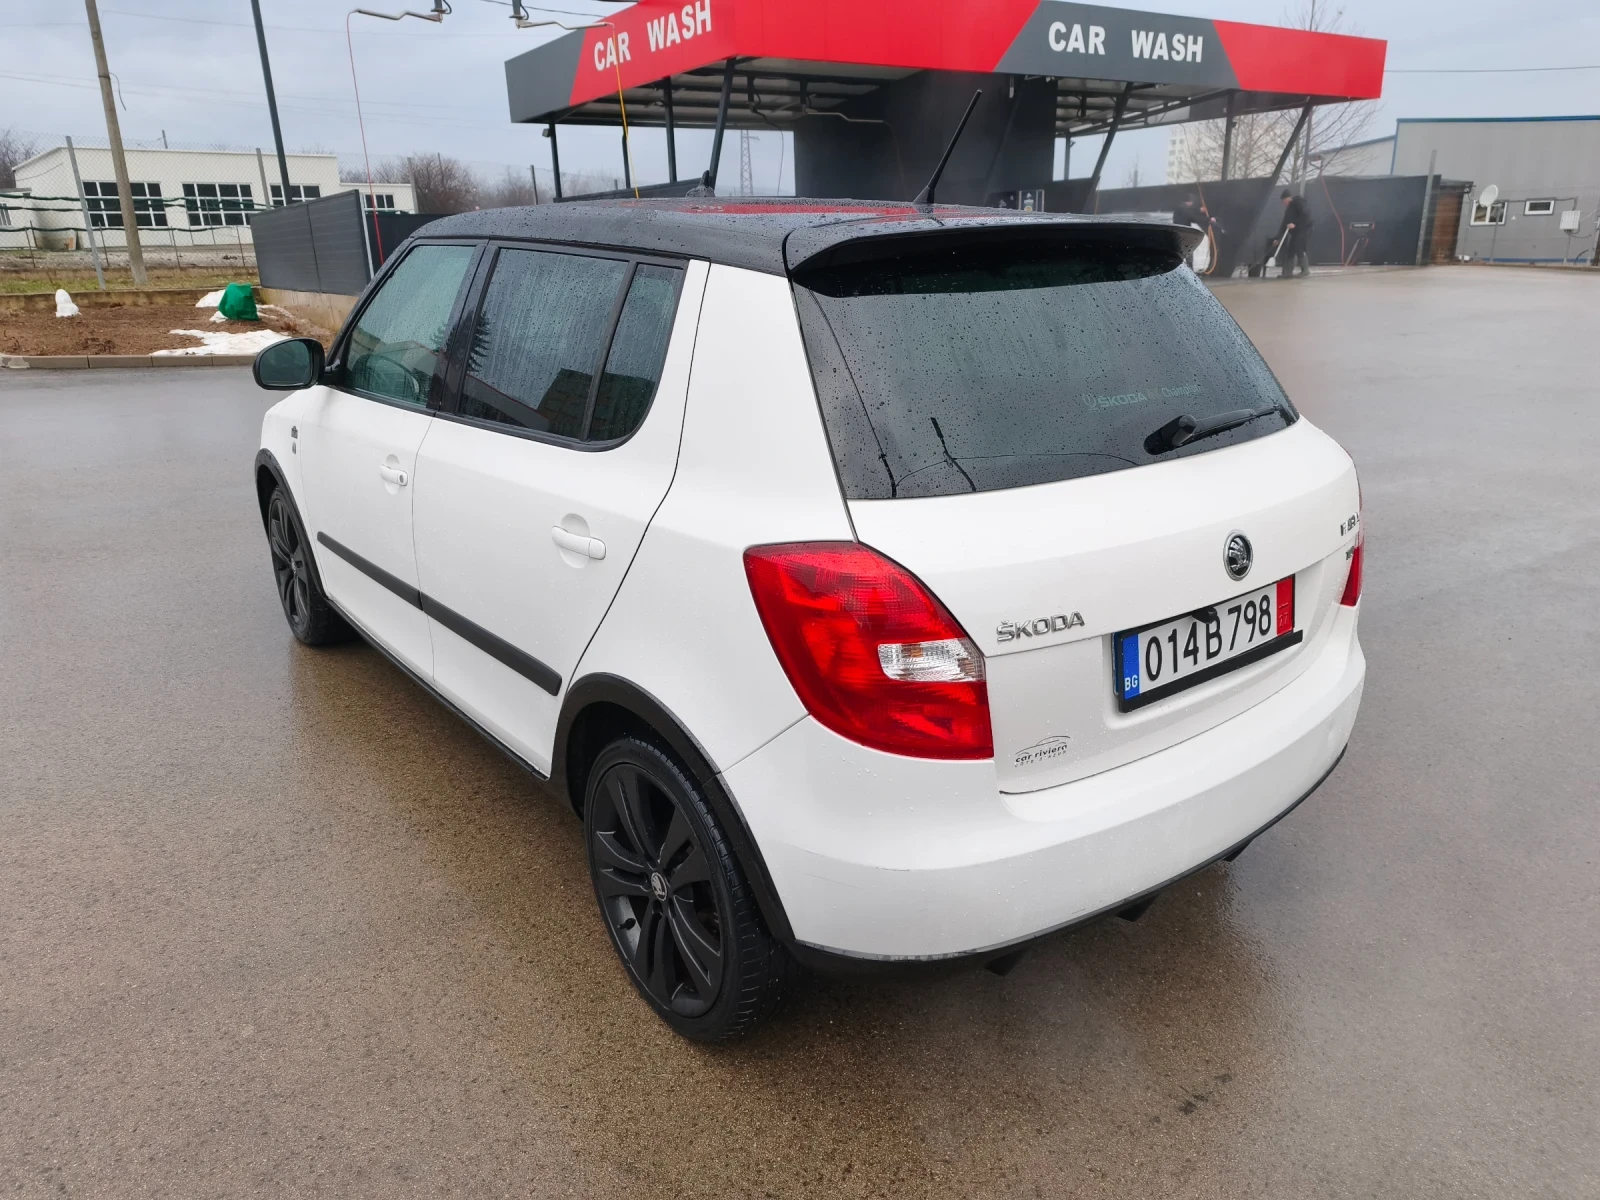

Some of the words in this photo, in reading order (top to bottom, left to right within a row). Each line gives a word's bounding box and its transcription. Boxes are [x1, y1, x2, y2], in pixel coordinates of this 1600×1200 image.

[593, 31, 631, 72] CAR
[646, 0, 712, 53] WASH
[1048, 21, 1106, 56] CAR
[1130, 29, 1204, 64] WASH
[996, 611, 1086, 644] ŠKODA
[1124, 674, 1139, 692] BG
[1015, 754, 1032, 763] car
[1034, 744, 1068, 758] riviera
